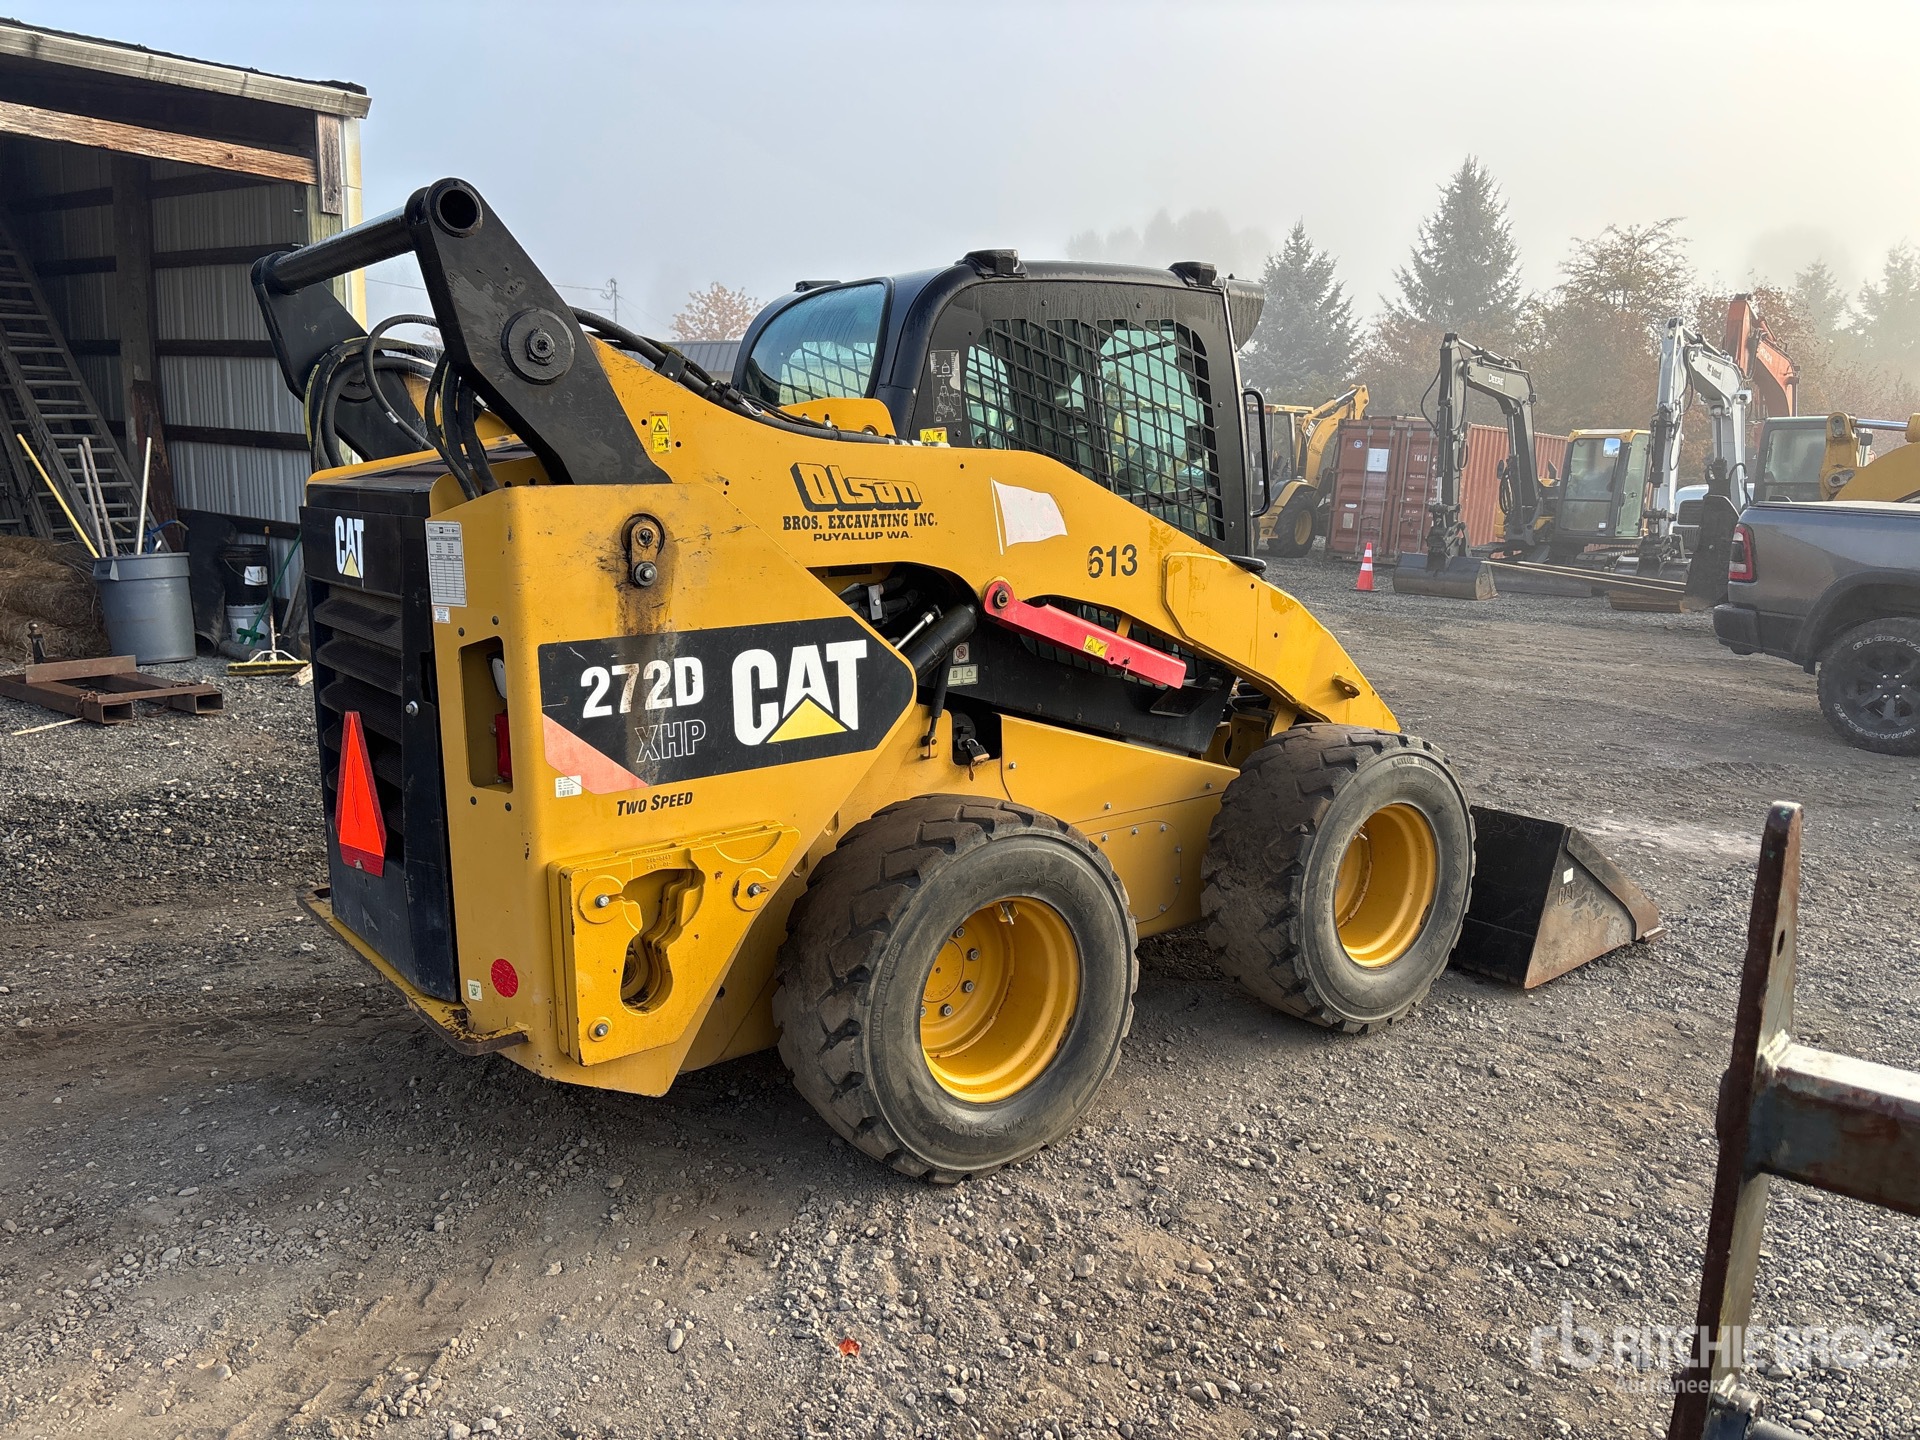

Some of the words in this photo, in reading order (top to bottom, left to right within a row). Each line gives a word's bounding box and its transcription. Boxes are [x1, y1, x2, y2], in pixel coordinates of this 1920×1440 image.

[1488, 373, 1504, 386] DEERE
[1305, 420, 1316, 437] CAT
[783, 515, 822, 531] BROS.
[828, 512, 909, 529] EXCAVATING
[914, 512, 938, 527] INC.
[813, 531, 884, 541] PUYALLUP
[887, 530, 913, 540] WA.
[335, 515, 364, 578] CAT
[1087, 544, 1138, 579] 613
[580, 656, 705, 719] 272D
[732, 639, 867, 746] CAT
[635, 719, 706, 763] XHP
